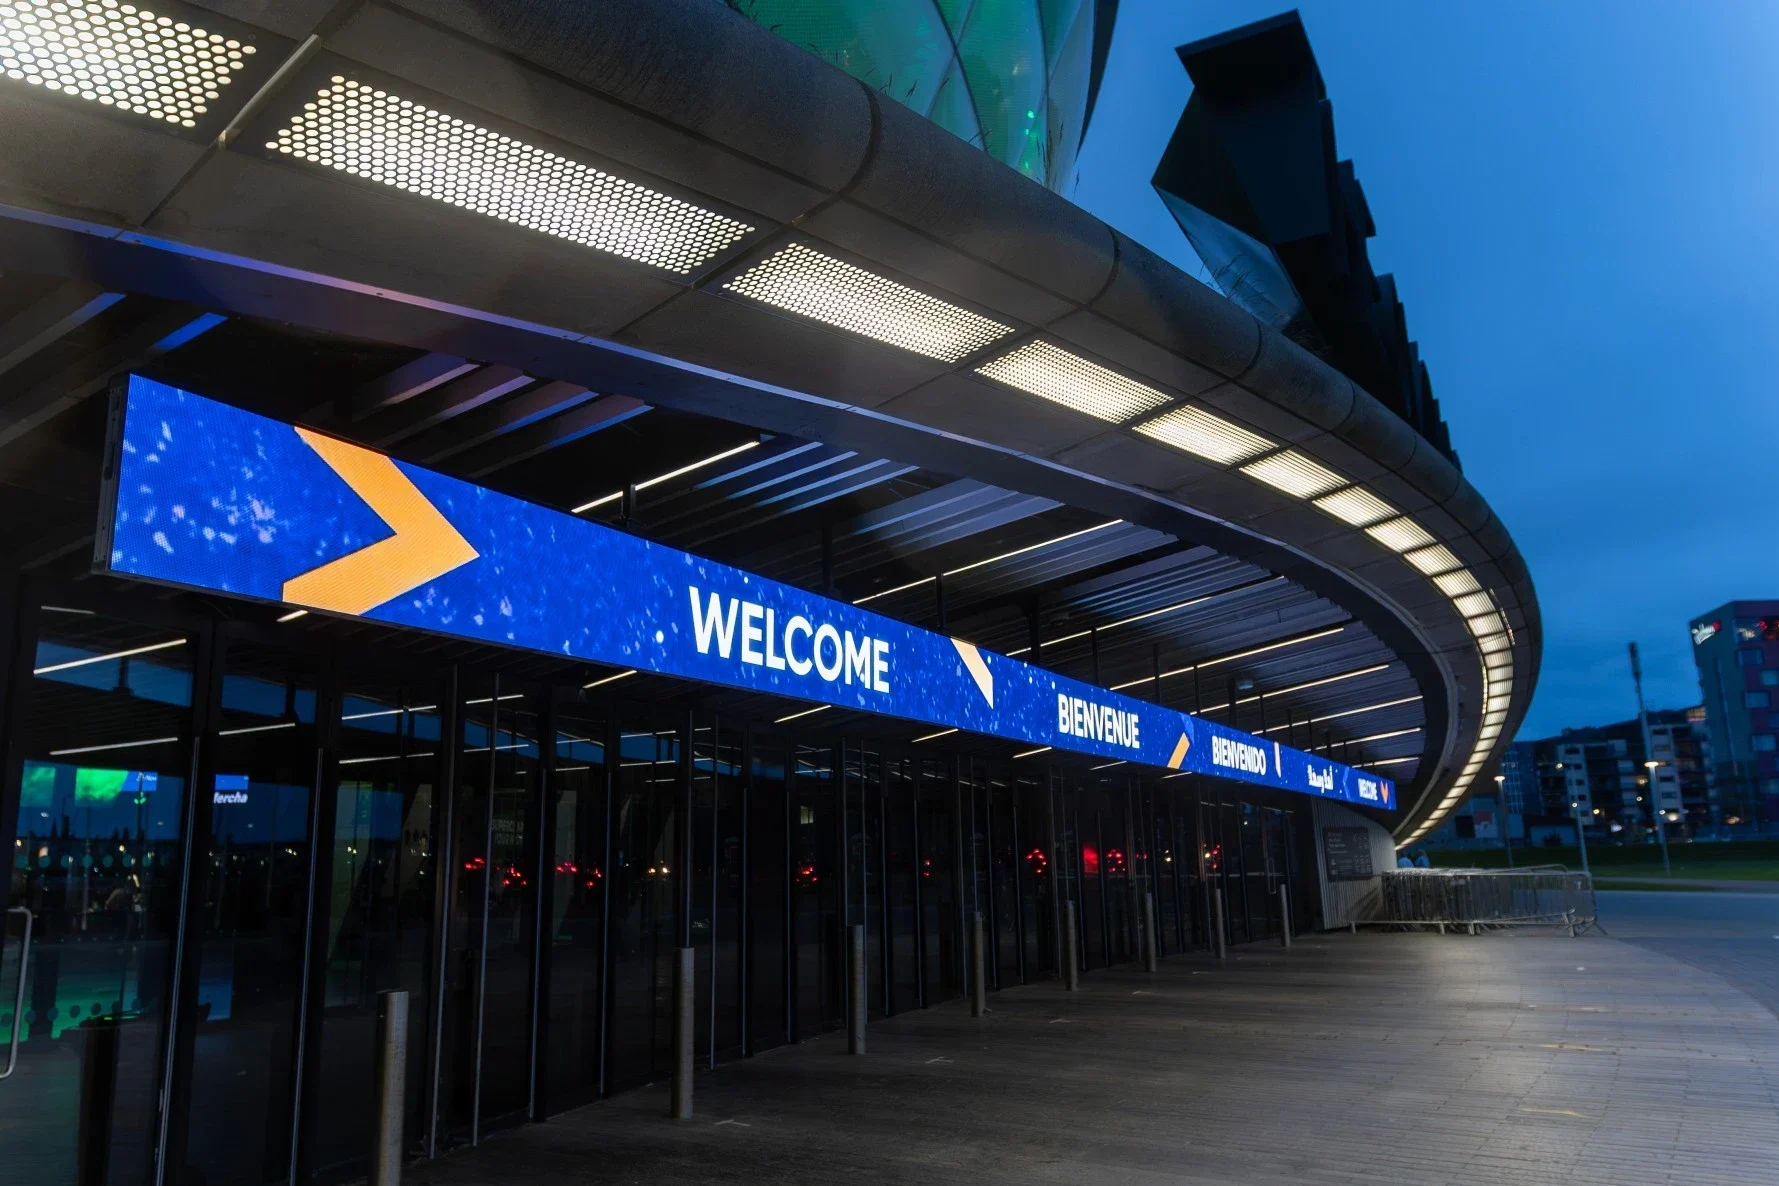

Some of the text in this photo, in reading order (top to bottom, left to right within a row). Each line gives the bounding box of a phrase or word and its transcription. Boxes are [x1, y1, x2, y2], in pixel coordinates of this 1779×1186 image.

[688, 585, 890, 694] WELCOME
[1058, 693, 1140, 748] BIENVENUE
[1212, 735, 1267, 776] BIENVENIDO
